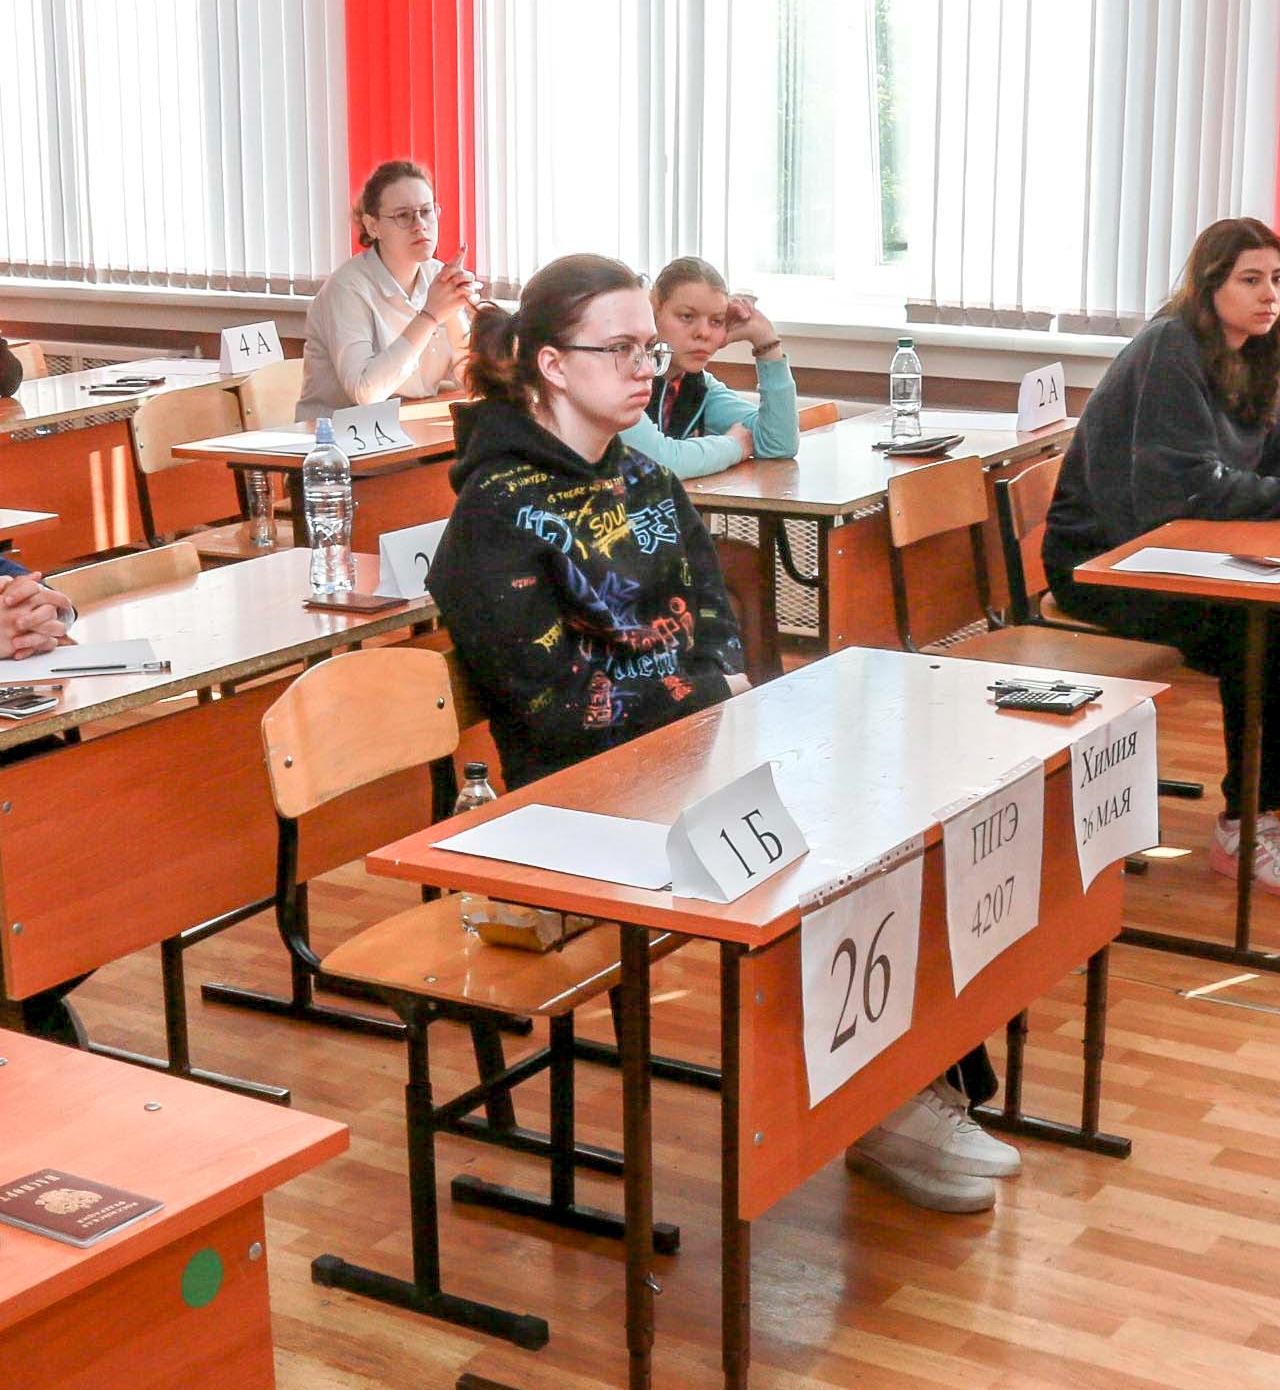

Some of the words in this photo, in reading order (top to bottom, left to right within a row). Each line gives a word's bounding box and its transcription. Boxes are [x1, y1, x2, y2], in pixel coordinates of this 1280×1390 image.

[239, 332, 251, 357] 4
[257, 331, 272, 355] А
[1036, 378, 1046, 408] 2
[1048, 375, 1058, 404] А
[346, 424, 367, 450] 3
[374, 420, 397, 446] А
[1080, 730, 1138, 790] Химия
[719, 827, 757, 879] 1
[740, 808, 783, 865] Б
[971, 801, 1019, 866] ППЭ
[1082, 809, 1094, 847] 26
[1096, 785, 1133, 833] МАЯ
[971, 875, 1016, 939] 4207
[830, 910, 896, 1054] 26
